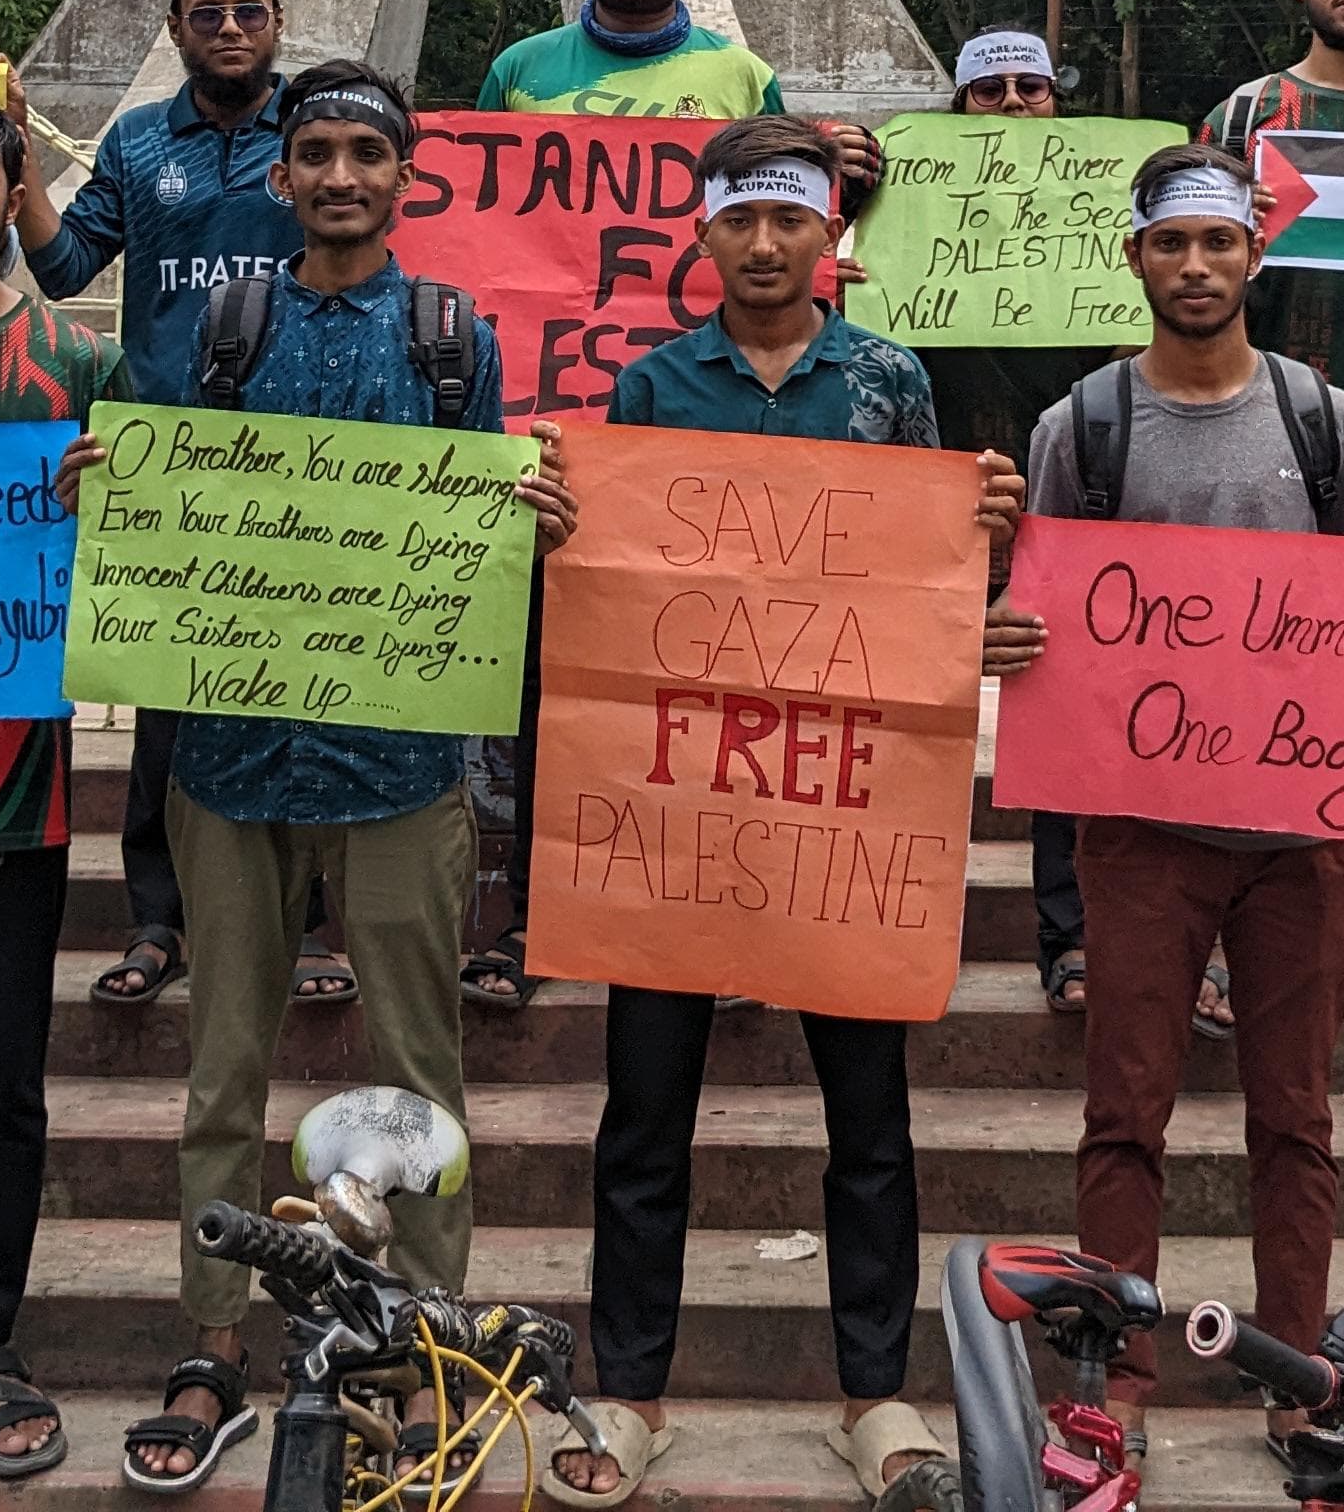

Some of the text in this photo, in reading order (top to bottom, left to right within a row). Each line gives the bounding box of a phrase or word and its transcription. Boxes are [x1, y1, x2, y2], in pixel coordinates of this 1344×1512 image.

[973, 49, 986, 58] WE
[988, 45, 1009, 55] ARE
[995, 54, 1038, 64] AL-AQSA
[342, 91, 385, 114] ISRAEL
[401, 128, 708, 221] STAND
[756, 169, 801, 183] ISRAEL
[883, 125, 1133, 187] From The River
[947, 190, 990, 233] To
[996, 187, 1051, 231] The
[882, 284, 1153, 332] Will Be Free
[108, 418, 156, 481] O
[301, 432, 343, 485] You
[355, 459, 402, 489] are
[98, 488, 490, 582] Even Your Brothers are Dying
[656, 476, 875, 579] SAVE
[89, 597, 157, 646] Your
[170, 607, 282, 651] Sisters
[303, 628, 366, 656] are
[90, 547, 473, 635] Innocent Childrens are Dying
[1085, 560, 1225, 651] One
[186, 656, 289, 709] Wake
[652, 590, 878, 705] GAZA
[645, 687, 883, 810] FREE
[1126, 680, 1248, 766] One
[573, 793, 947, 930] PALESTINE
